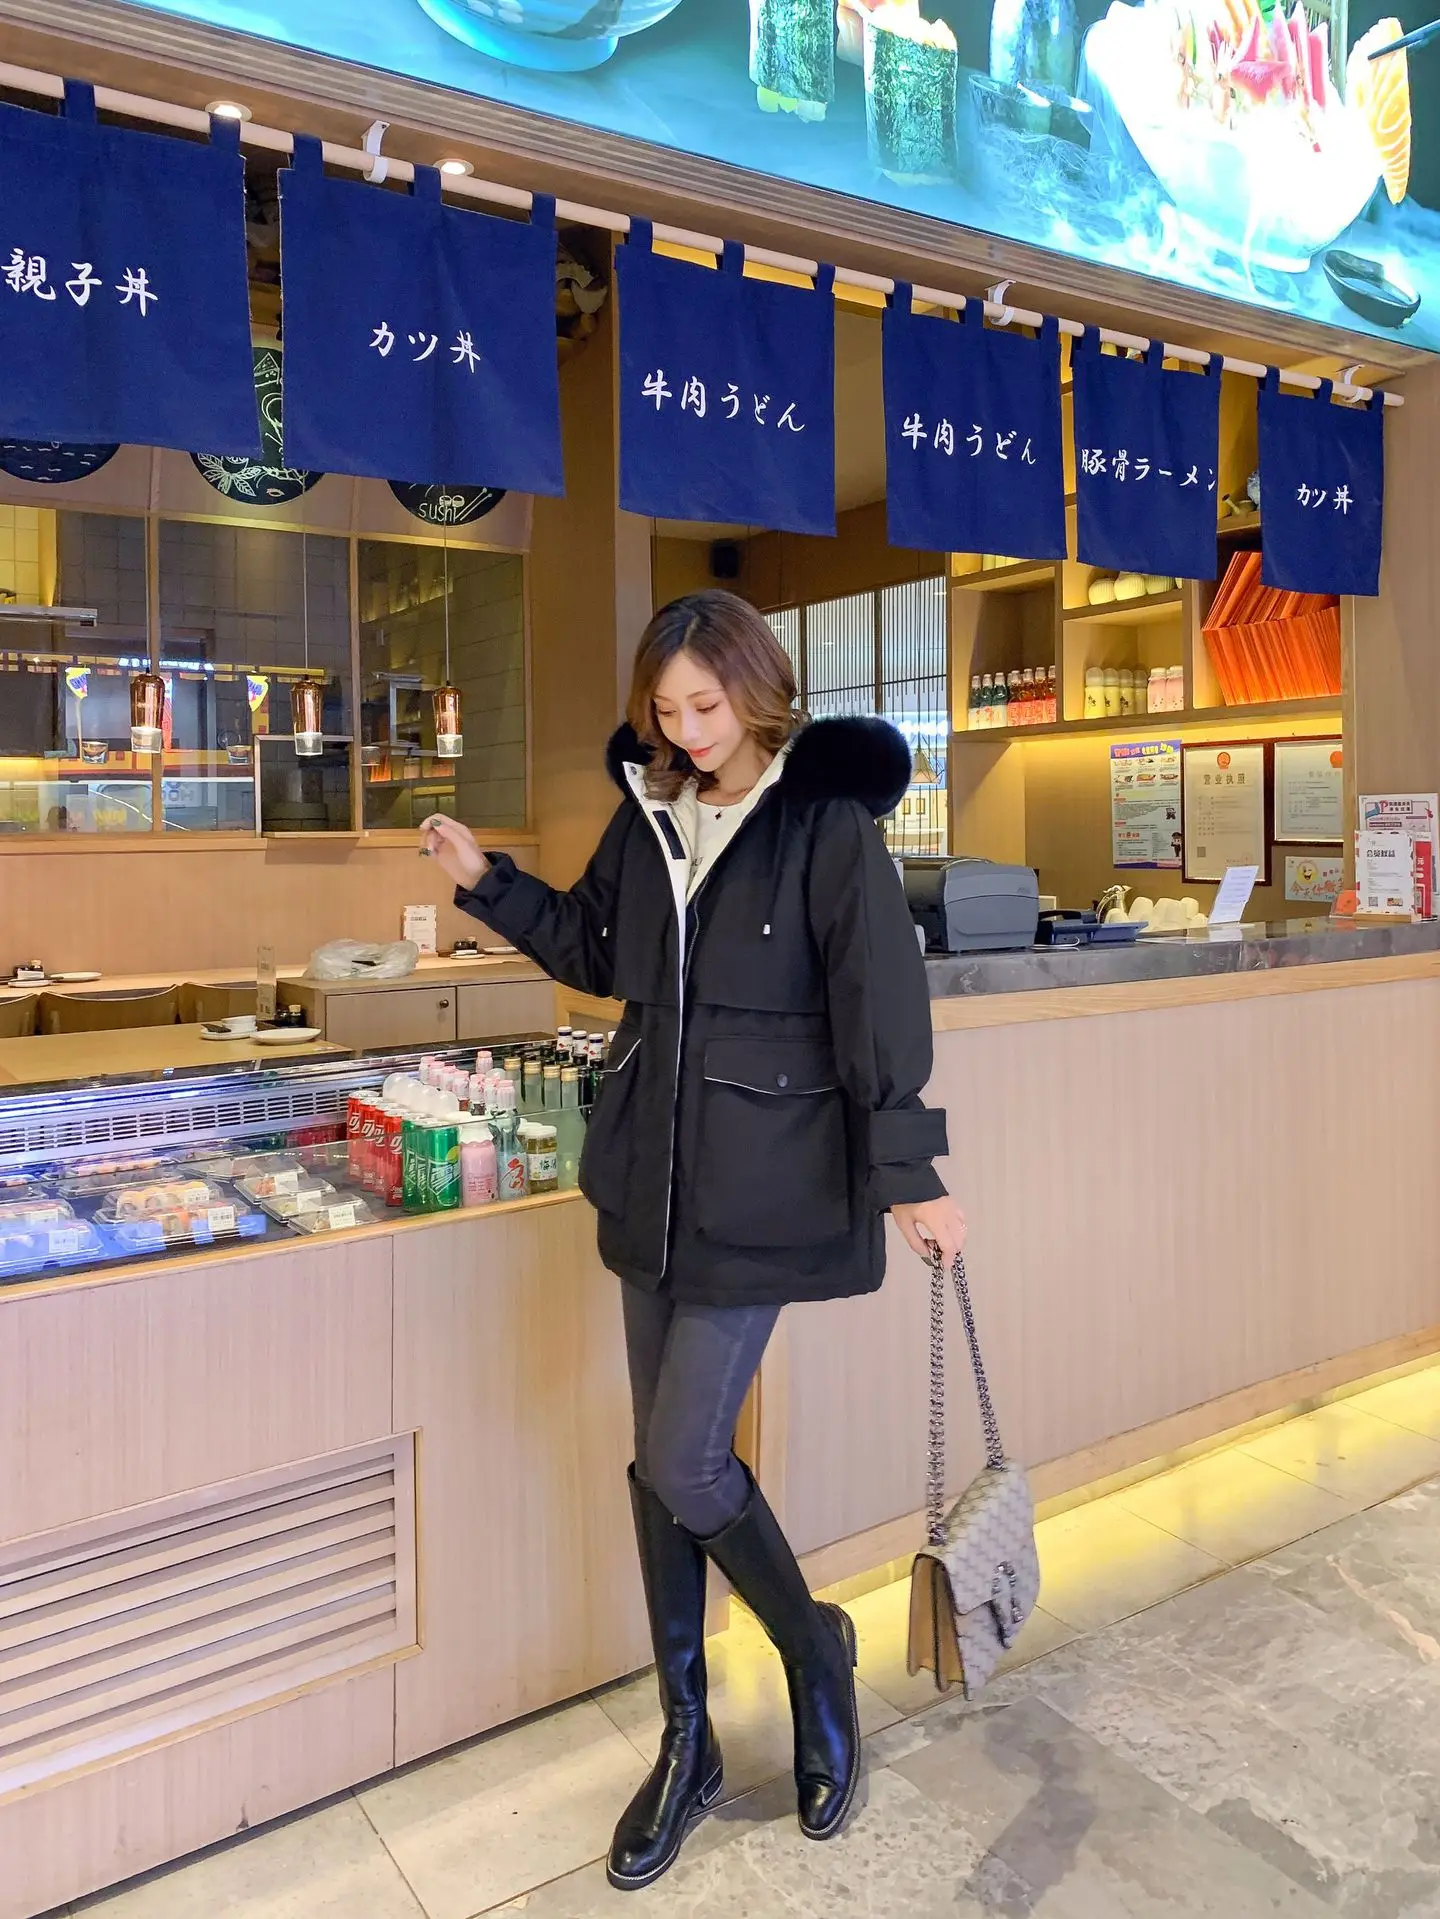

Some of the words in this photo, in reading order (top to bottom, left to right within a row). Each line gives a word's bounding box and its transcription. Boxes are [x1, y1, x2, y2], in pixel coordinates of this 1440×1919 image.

[1, 247, 159, 317] 親子丼
[369, 321, 481, 373] カツ丼
[641, 369, 806, 432] 牛肉うどん
[901, 412, 1037, 465] 牛肉うどん
[1296, 483, 1354, 515] カツ丼
[1203, 773, 1246, 785] 营业执照
